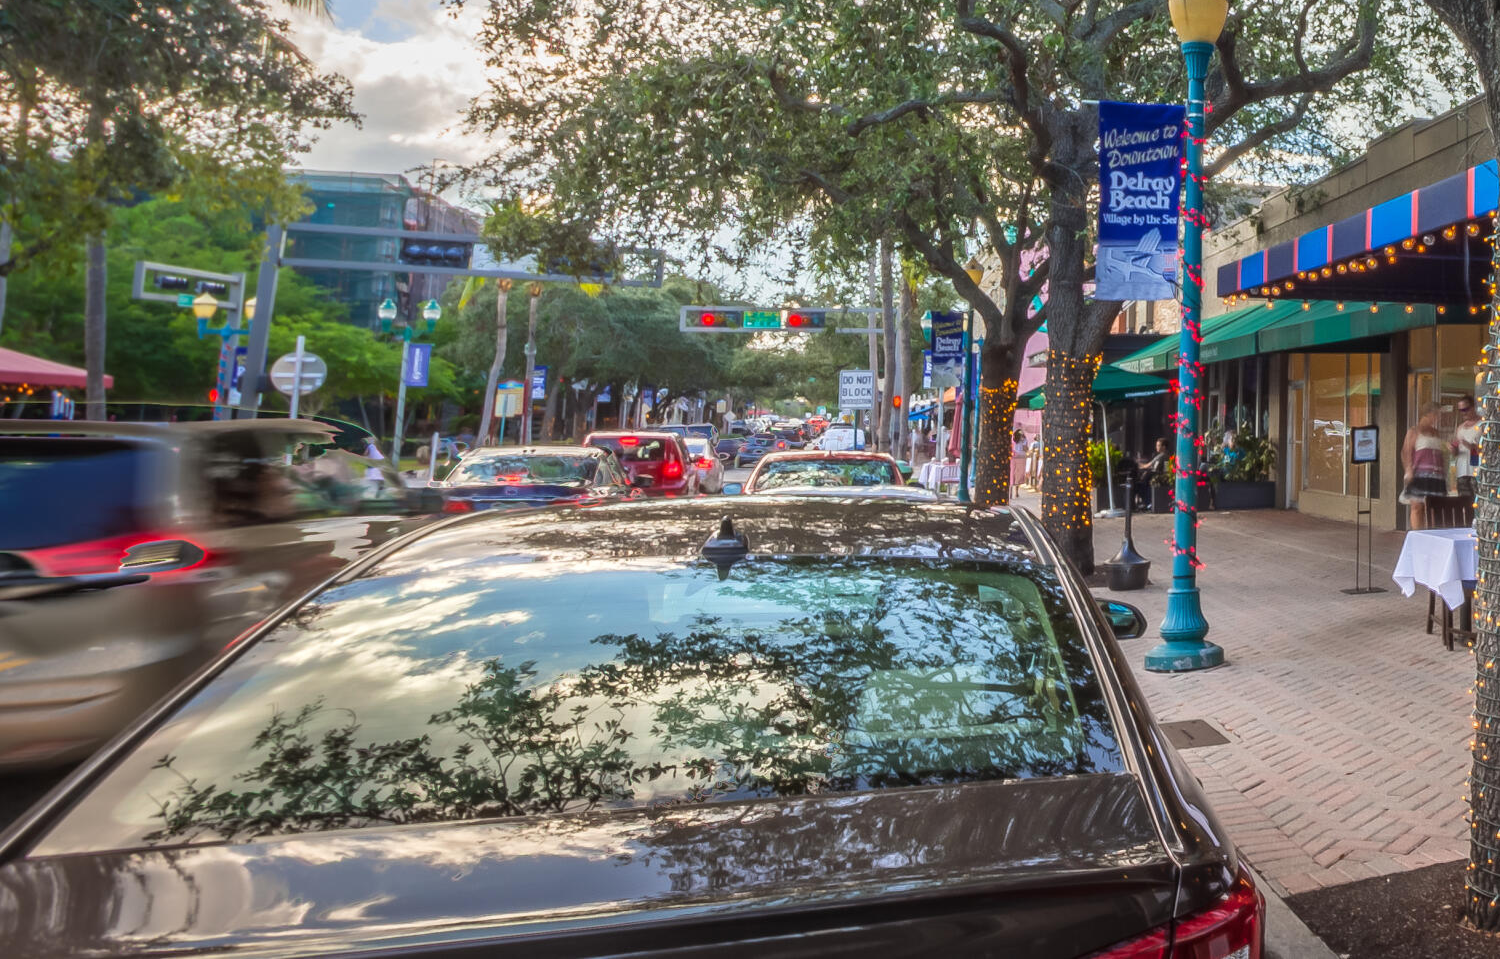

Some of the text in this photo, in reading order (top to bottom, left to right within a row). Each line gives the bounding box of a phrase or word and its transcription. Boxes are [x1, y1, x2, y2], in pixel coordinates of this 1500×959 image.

[1104, 125, 1178, 149] Welcome to
[1107, 145, 1179, 169] Downtown
[1110, 170, 1175, 195] Delray
[1109, 189, 1170, 212] Beach
[1102, 213, 1132, 226] Village
[1133, 214, 1145, 226] by
[1146, 214, 1161, 224] the
[842, 376, 873, 385] DO NOT
[842, 387, 872, 397] BLOCK
